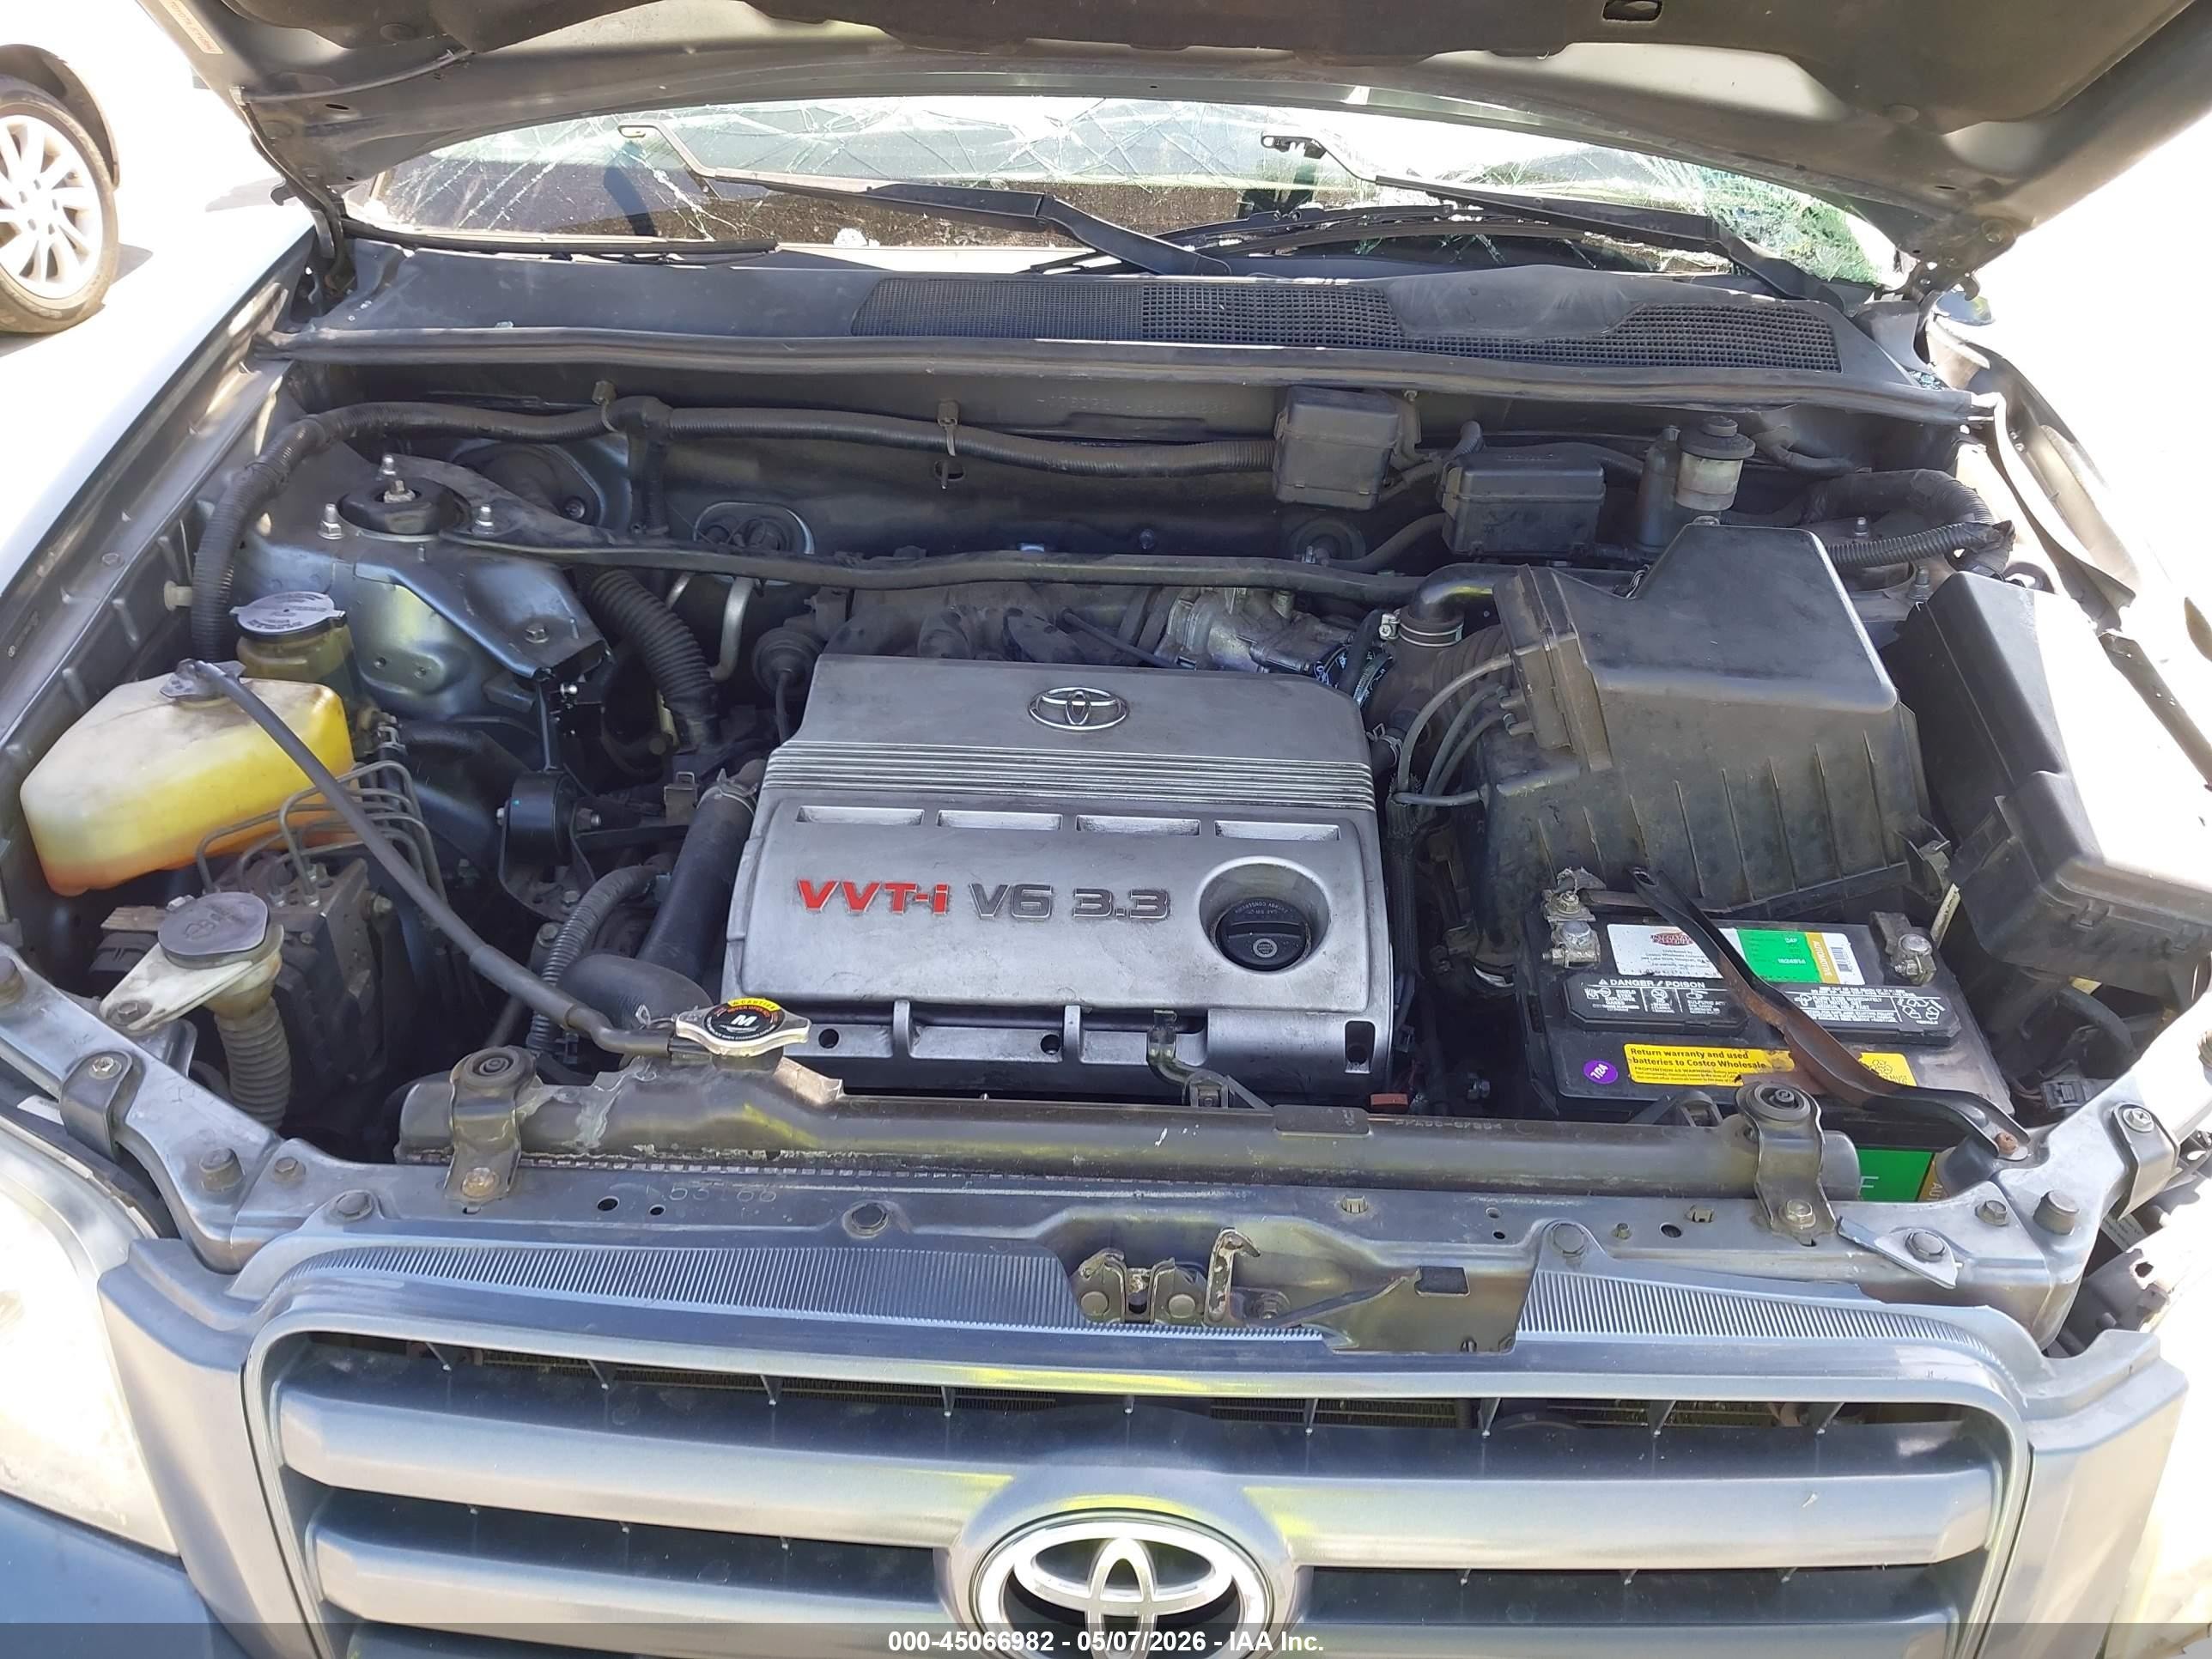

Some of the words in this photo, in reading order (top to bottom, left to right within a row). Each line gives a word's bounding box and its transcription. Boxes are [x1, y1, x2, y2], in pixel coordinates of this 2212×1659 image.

[798, 879, 950, 915] VVT-i
[969, 883, 1054, 919] V6
[1073, 888, 1169, 921] 3.3
[731, 1014, 758, 1027] M
[1630, 1048, 1662, 1056] Return
[1664, 1050, 1705, 1060] warranty
[1707, 1050, 1725, 1059] and
[1727, 1051, 1749, 1060] used
[1632, 1057, 1674, 1066] batteries
[1686, 1059, 1717, 1067] Costco
[1717, 1059, 1766, 1068] Wholesale
